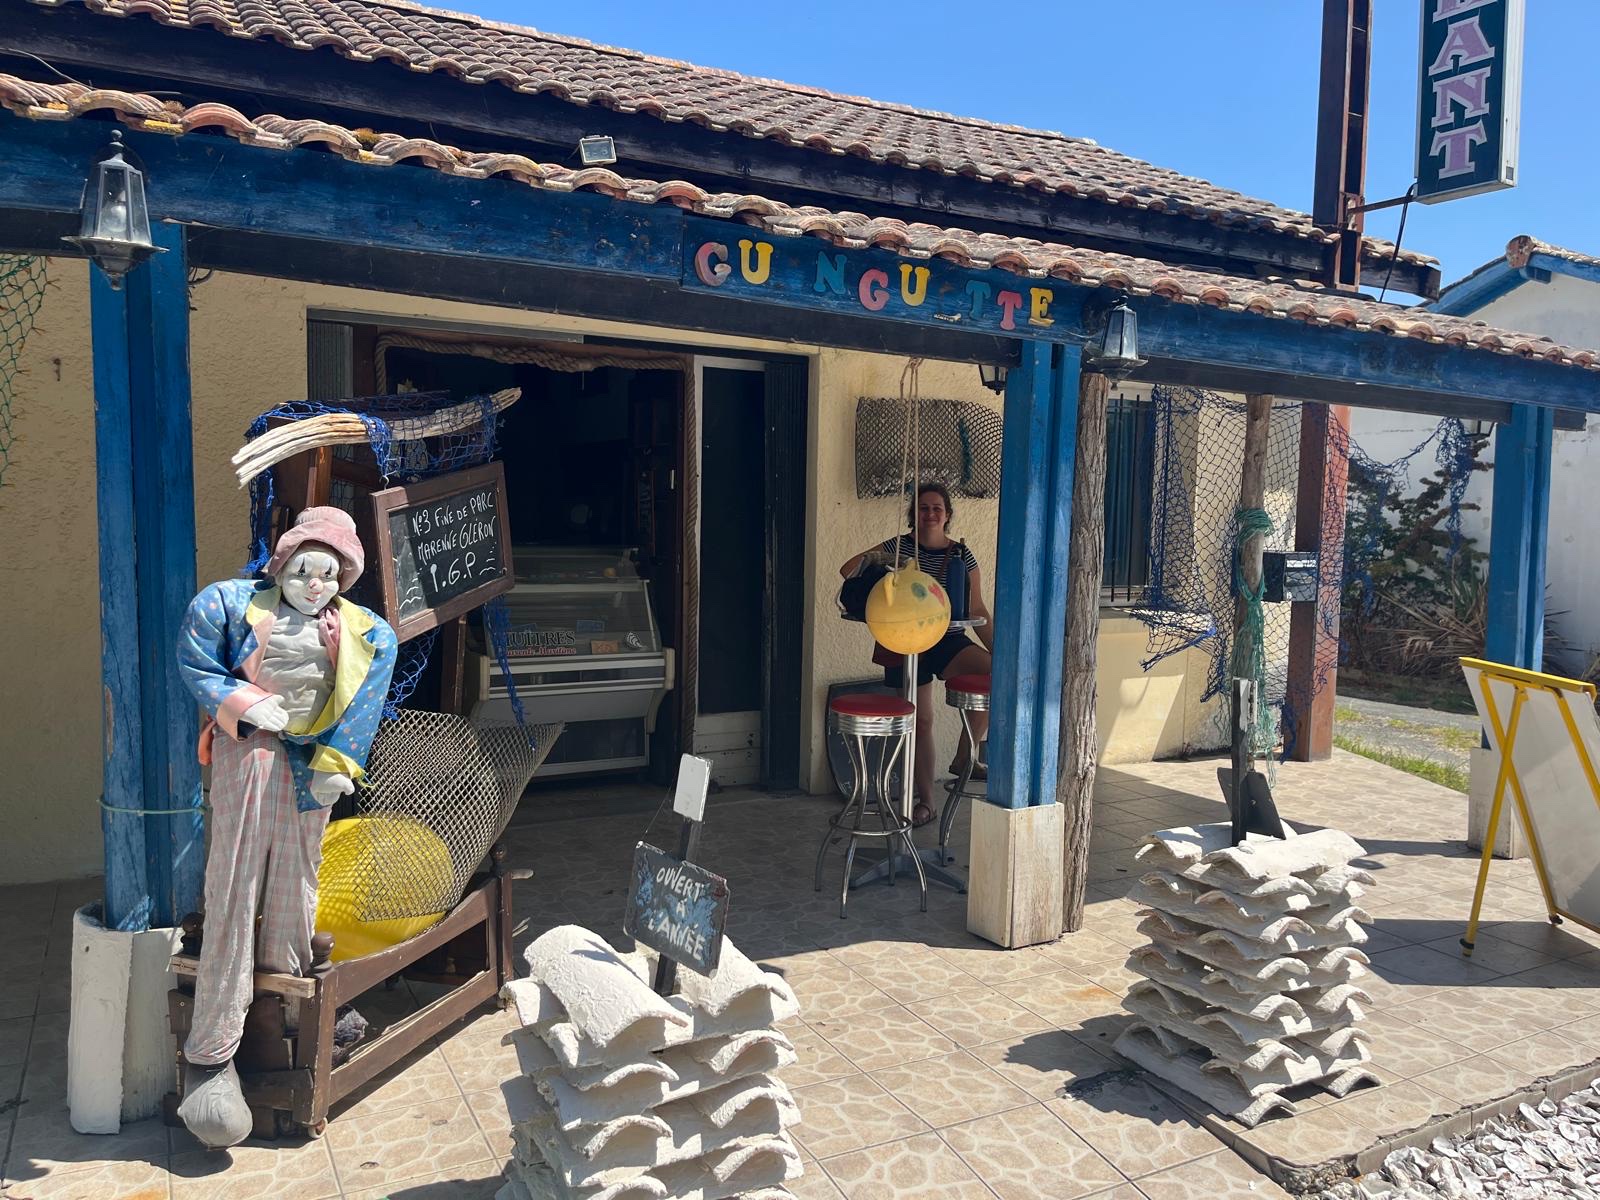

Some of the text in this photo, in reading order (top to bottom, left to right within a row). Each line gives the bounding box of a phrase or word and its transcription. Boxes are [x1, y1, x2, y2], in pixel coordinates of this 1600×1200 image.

[457, 505, 468, 520] DE
[470, 492, 493, 514] PARC
[417, 530, 457, 565] MARENNE
[656, 866, 703, 902] OUVERT
